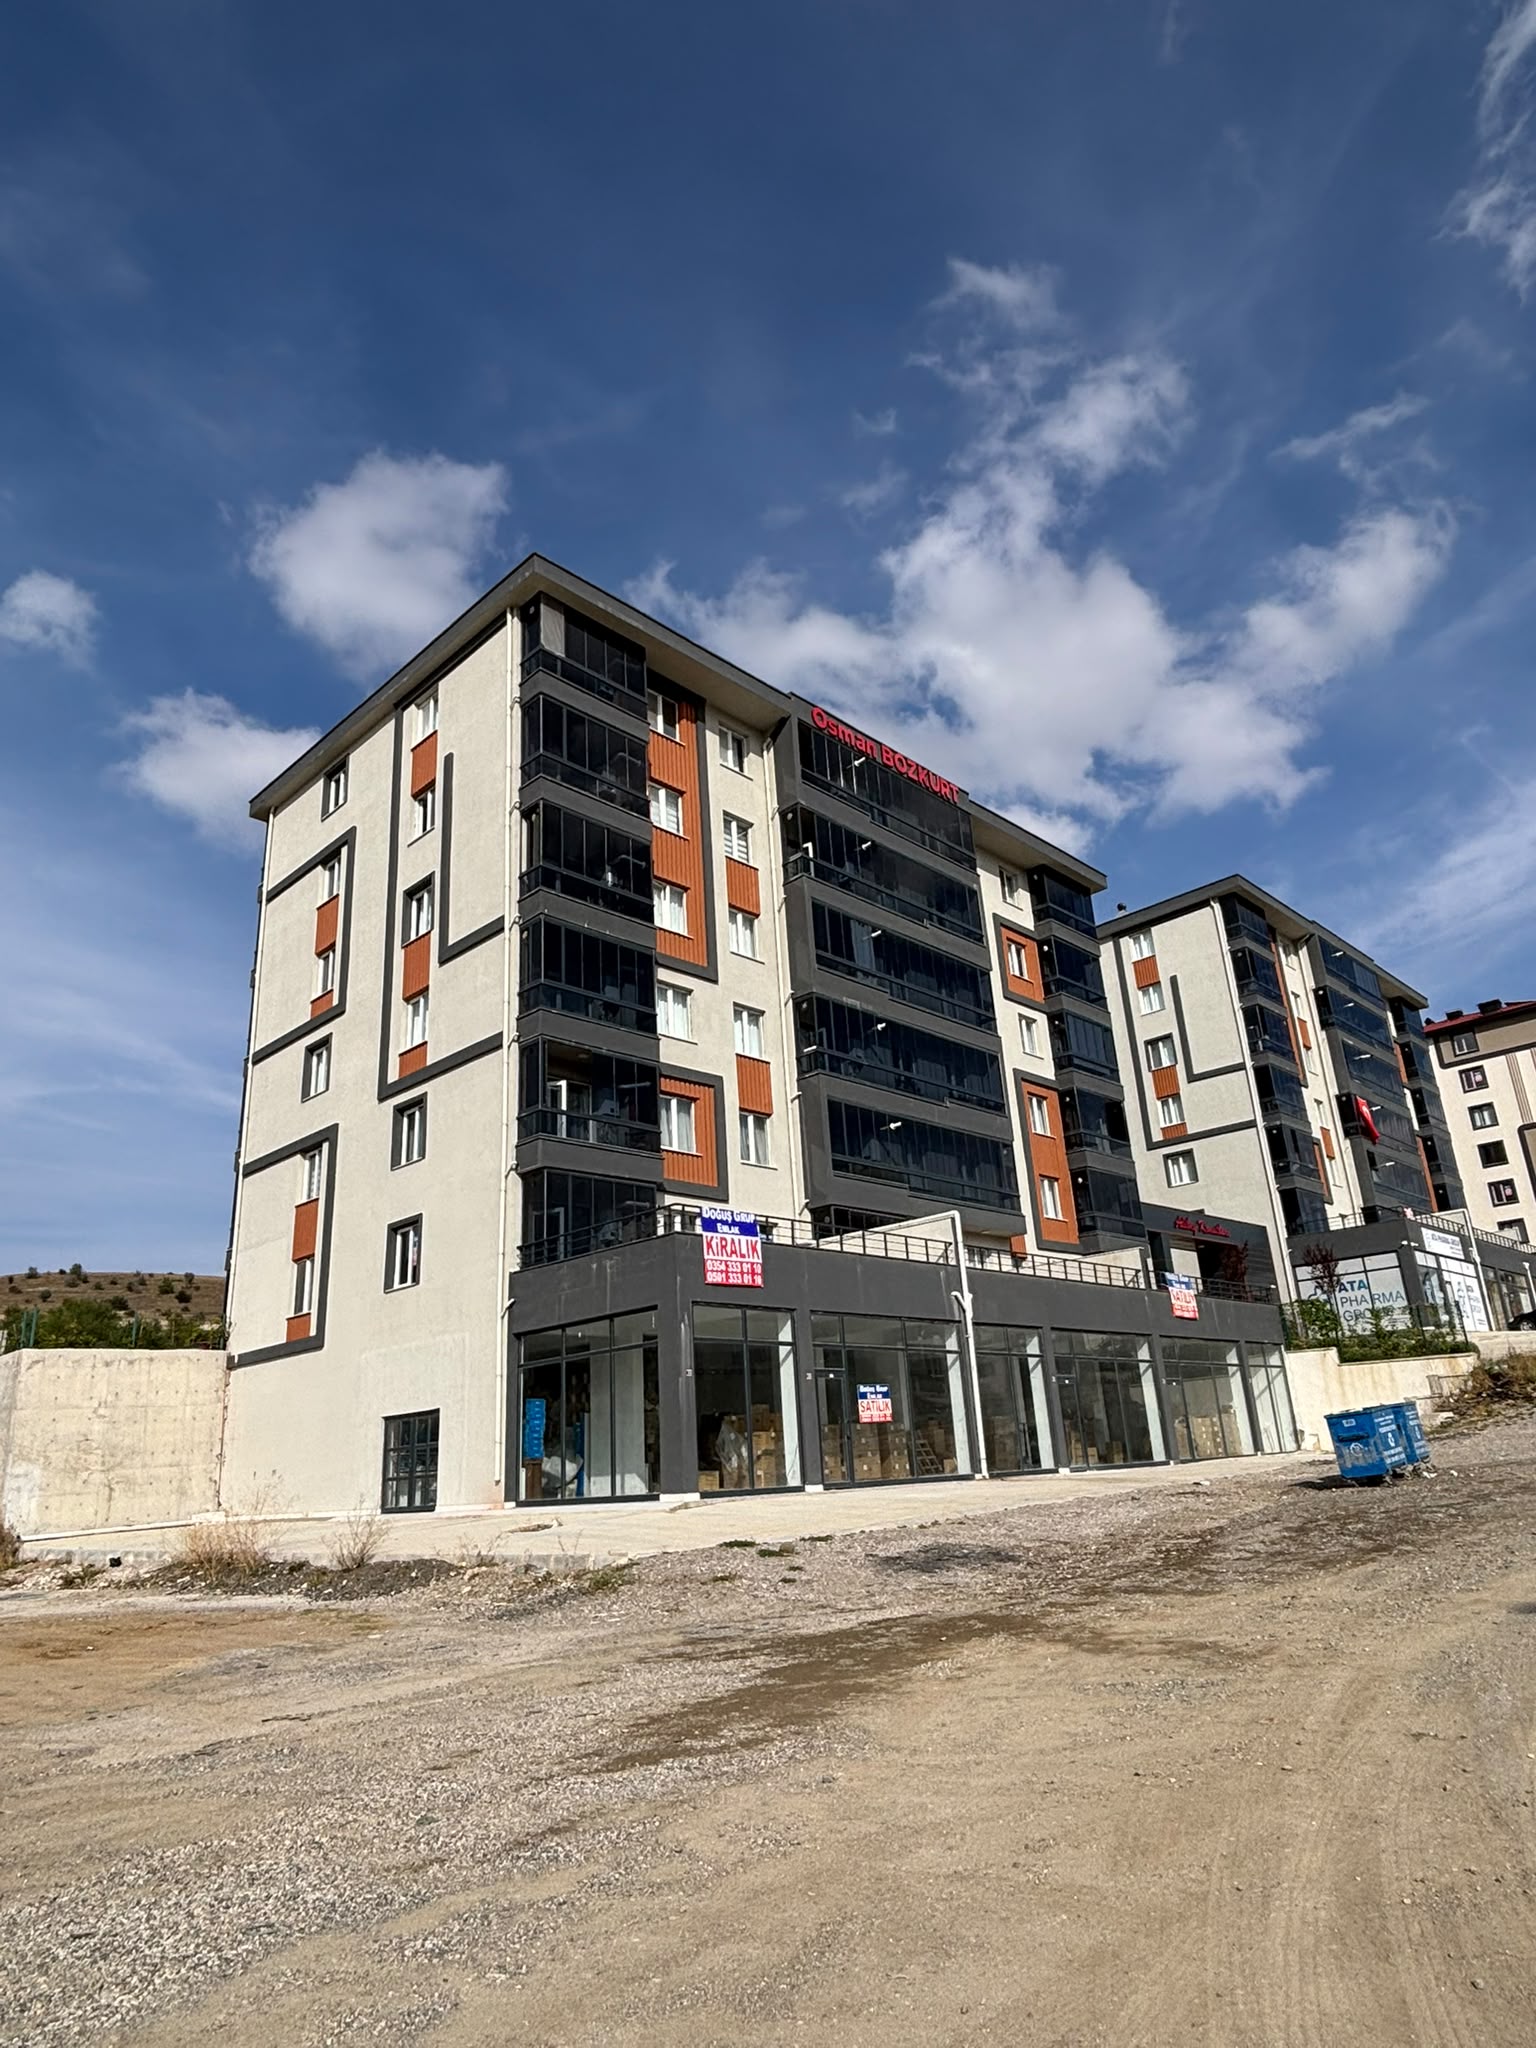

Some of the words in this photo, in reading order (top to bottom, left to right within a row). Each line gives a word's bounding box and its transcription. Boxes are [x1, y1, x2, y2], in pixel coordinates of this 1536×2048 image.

[811, 706, 878, 759] Osman
[880, 744, 961, 804] BOZKURT
[706, 1260, 726, 1271] 0354
[727, 1261, 742, 1273] 333
[727, 1273, 742, 1283] 333
[1338, 1279, 1368, 1293] ATA
[1340, 1290, 1405, 1308] PHARMA
[1343, 1307, 1378, 1322] GRO
